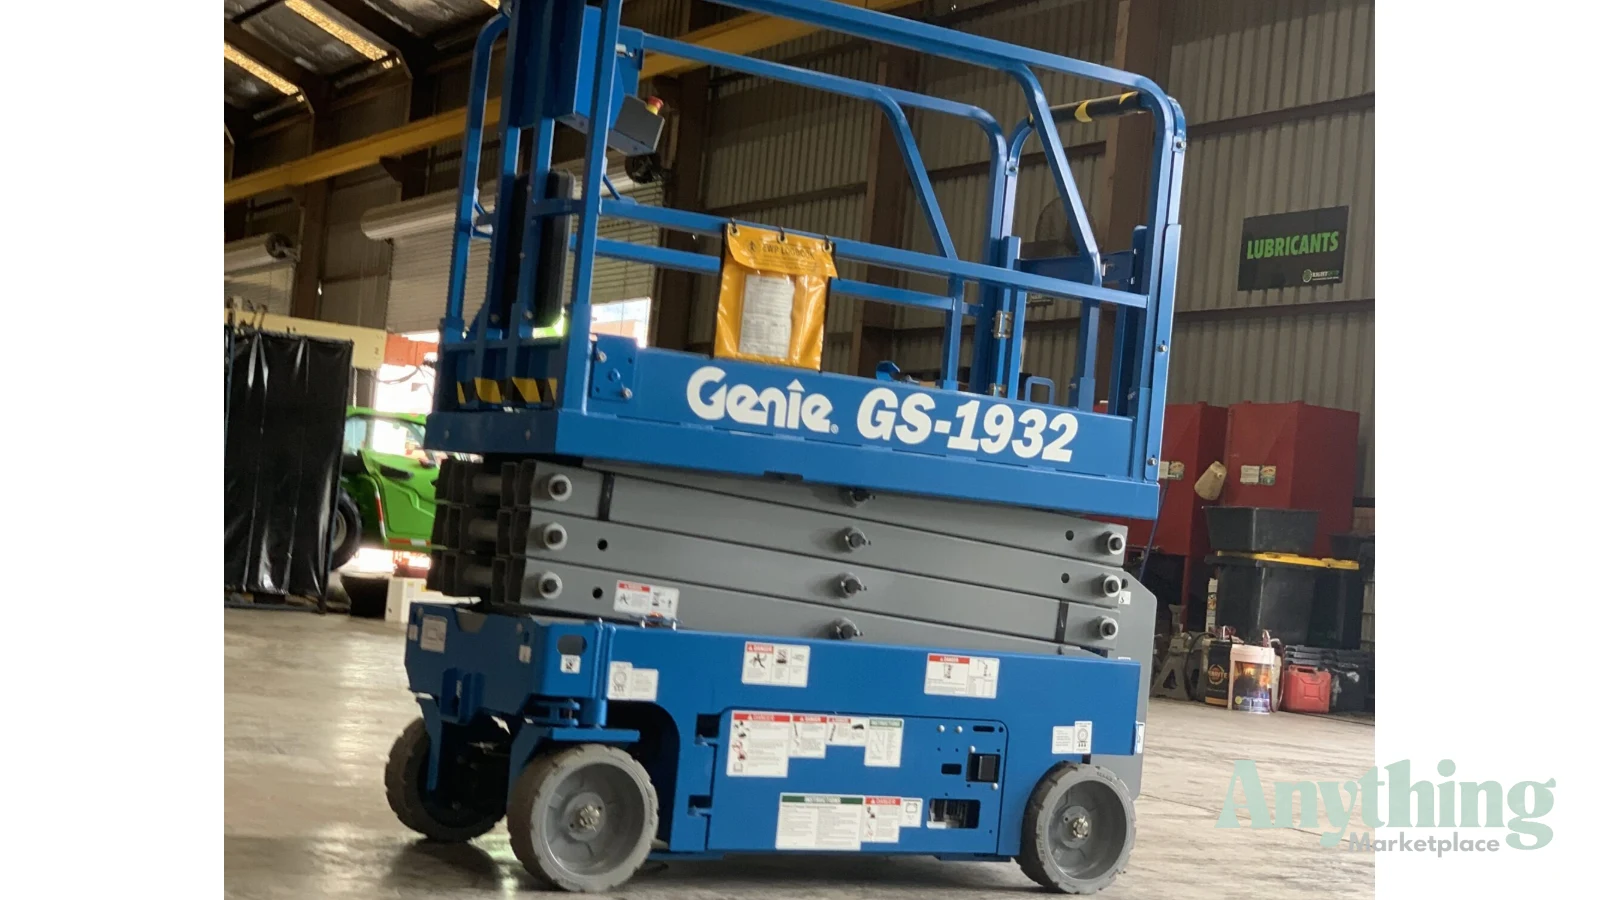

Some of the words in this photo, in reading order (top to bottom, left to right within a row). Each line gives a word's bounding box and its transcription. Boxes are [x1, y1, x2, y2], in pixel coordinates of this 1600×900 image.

[1247, 231, 1339, 260] LUBRICANTS
[686, 365, 833, 433] Genie
[856, 387, 1079, 463] GS-1932
